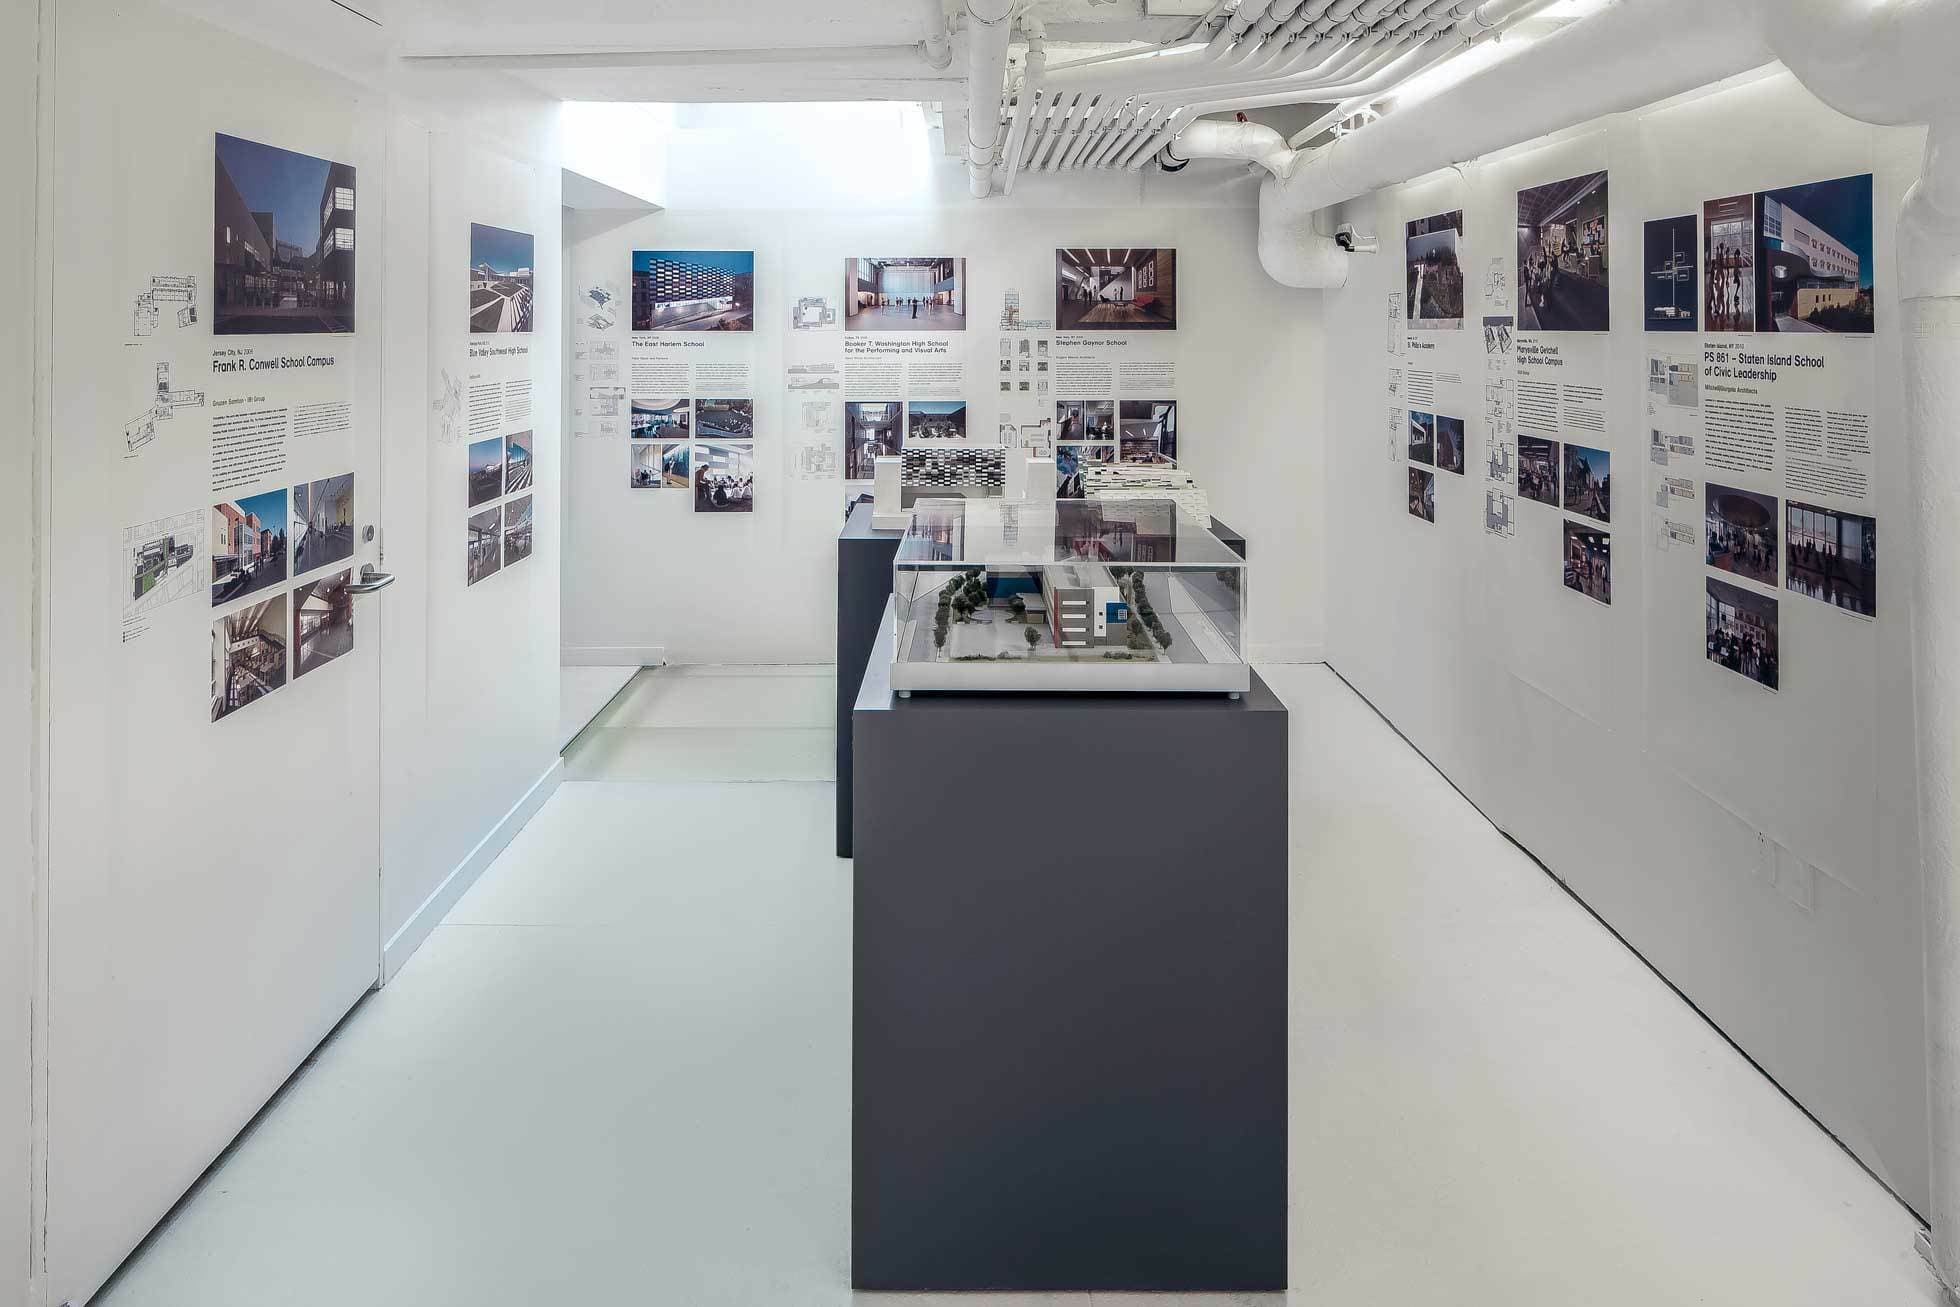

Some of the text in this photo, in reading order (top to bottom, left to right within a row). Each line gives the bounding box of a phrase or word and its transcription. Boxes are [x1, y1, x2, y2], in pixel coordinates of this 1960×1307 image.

[1517, 345, 1539, 354] Marysville
[213, 355, 336, 372] Frank R. Conwell School Campus
[1517, 356, 1563, 366] High School Campus
[1704, 352, 1715, 362] PS
[1716, 352, 1729, 363] 861
[1739, 352, 1765, 365] Staten
[1767, 354, 1792, 366] Island
[1794, 355, 1824, 368] School
[1704, 366, 1777, 383] of Civic Leadership
